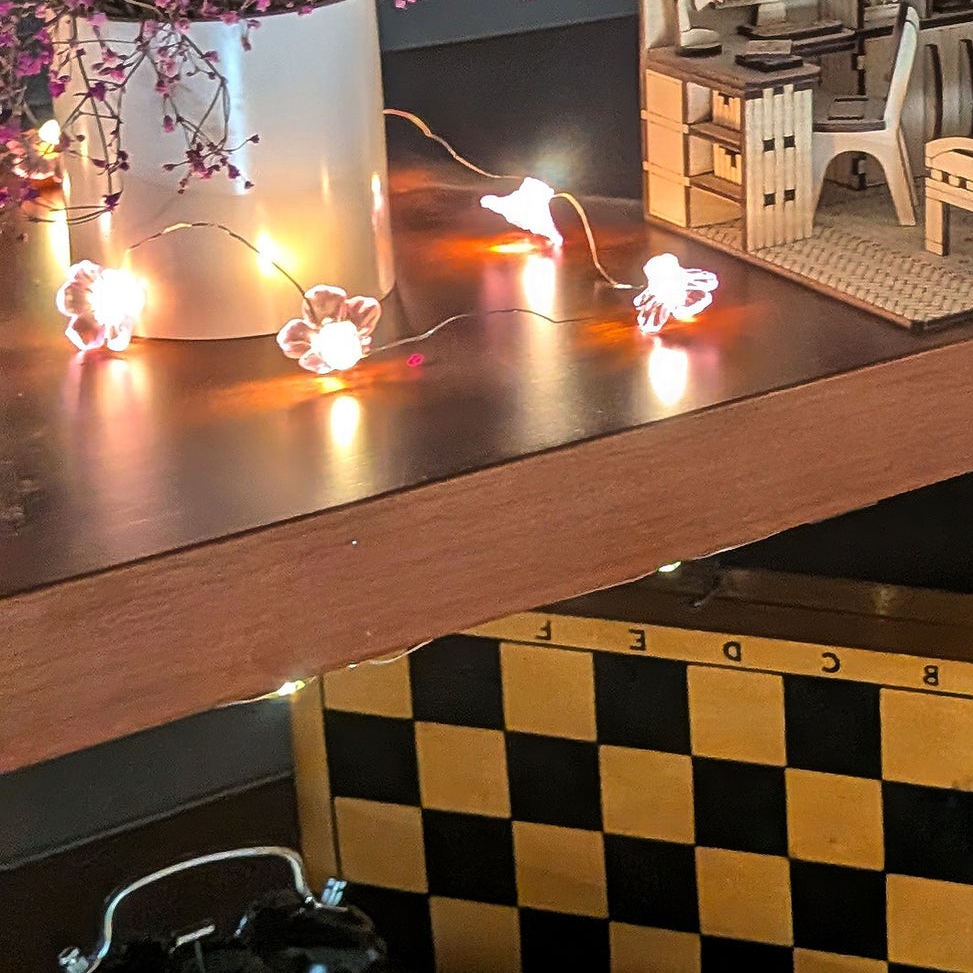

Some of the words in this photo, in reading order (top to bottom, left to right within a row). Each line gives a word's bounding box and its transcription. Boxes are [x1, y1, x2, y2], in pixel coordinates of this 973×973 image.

[629, 629, 646, 651] E
[723, 641, 742, 662] D
[821, 652, 841, 674] C
[923, 665, 939, 687] B
